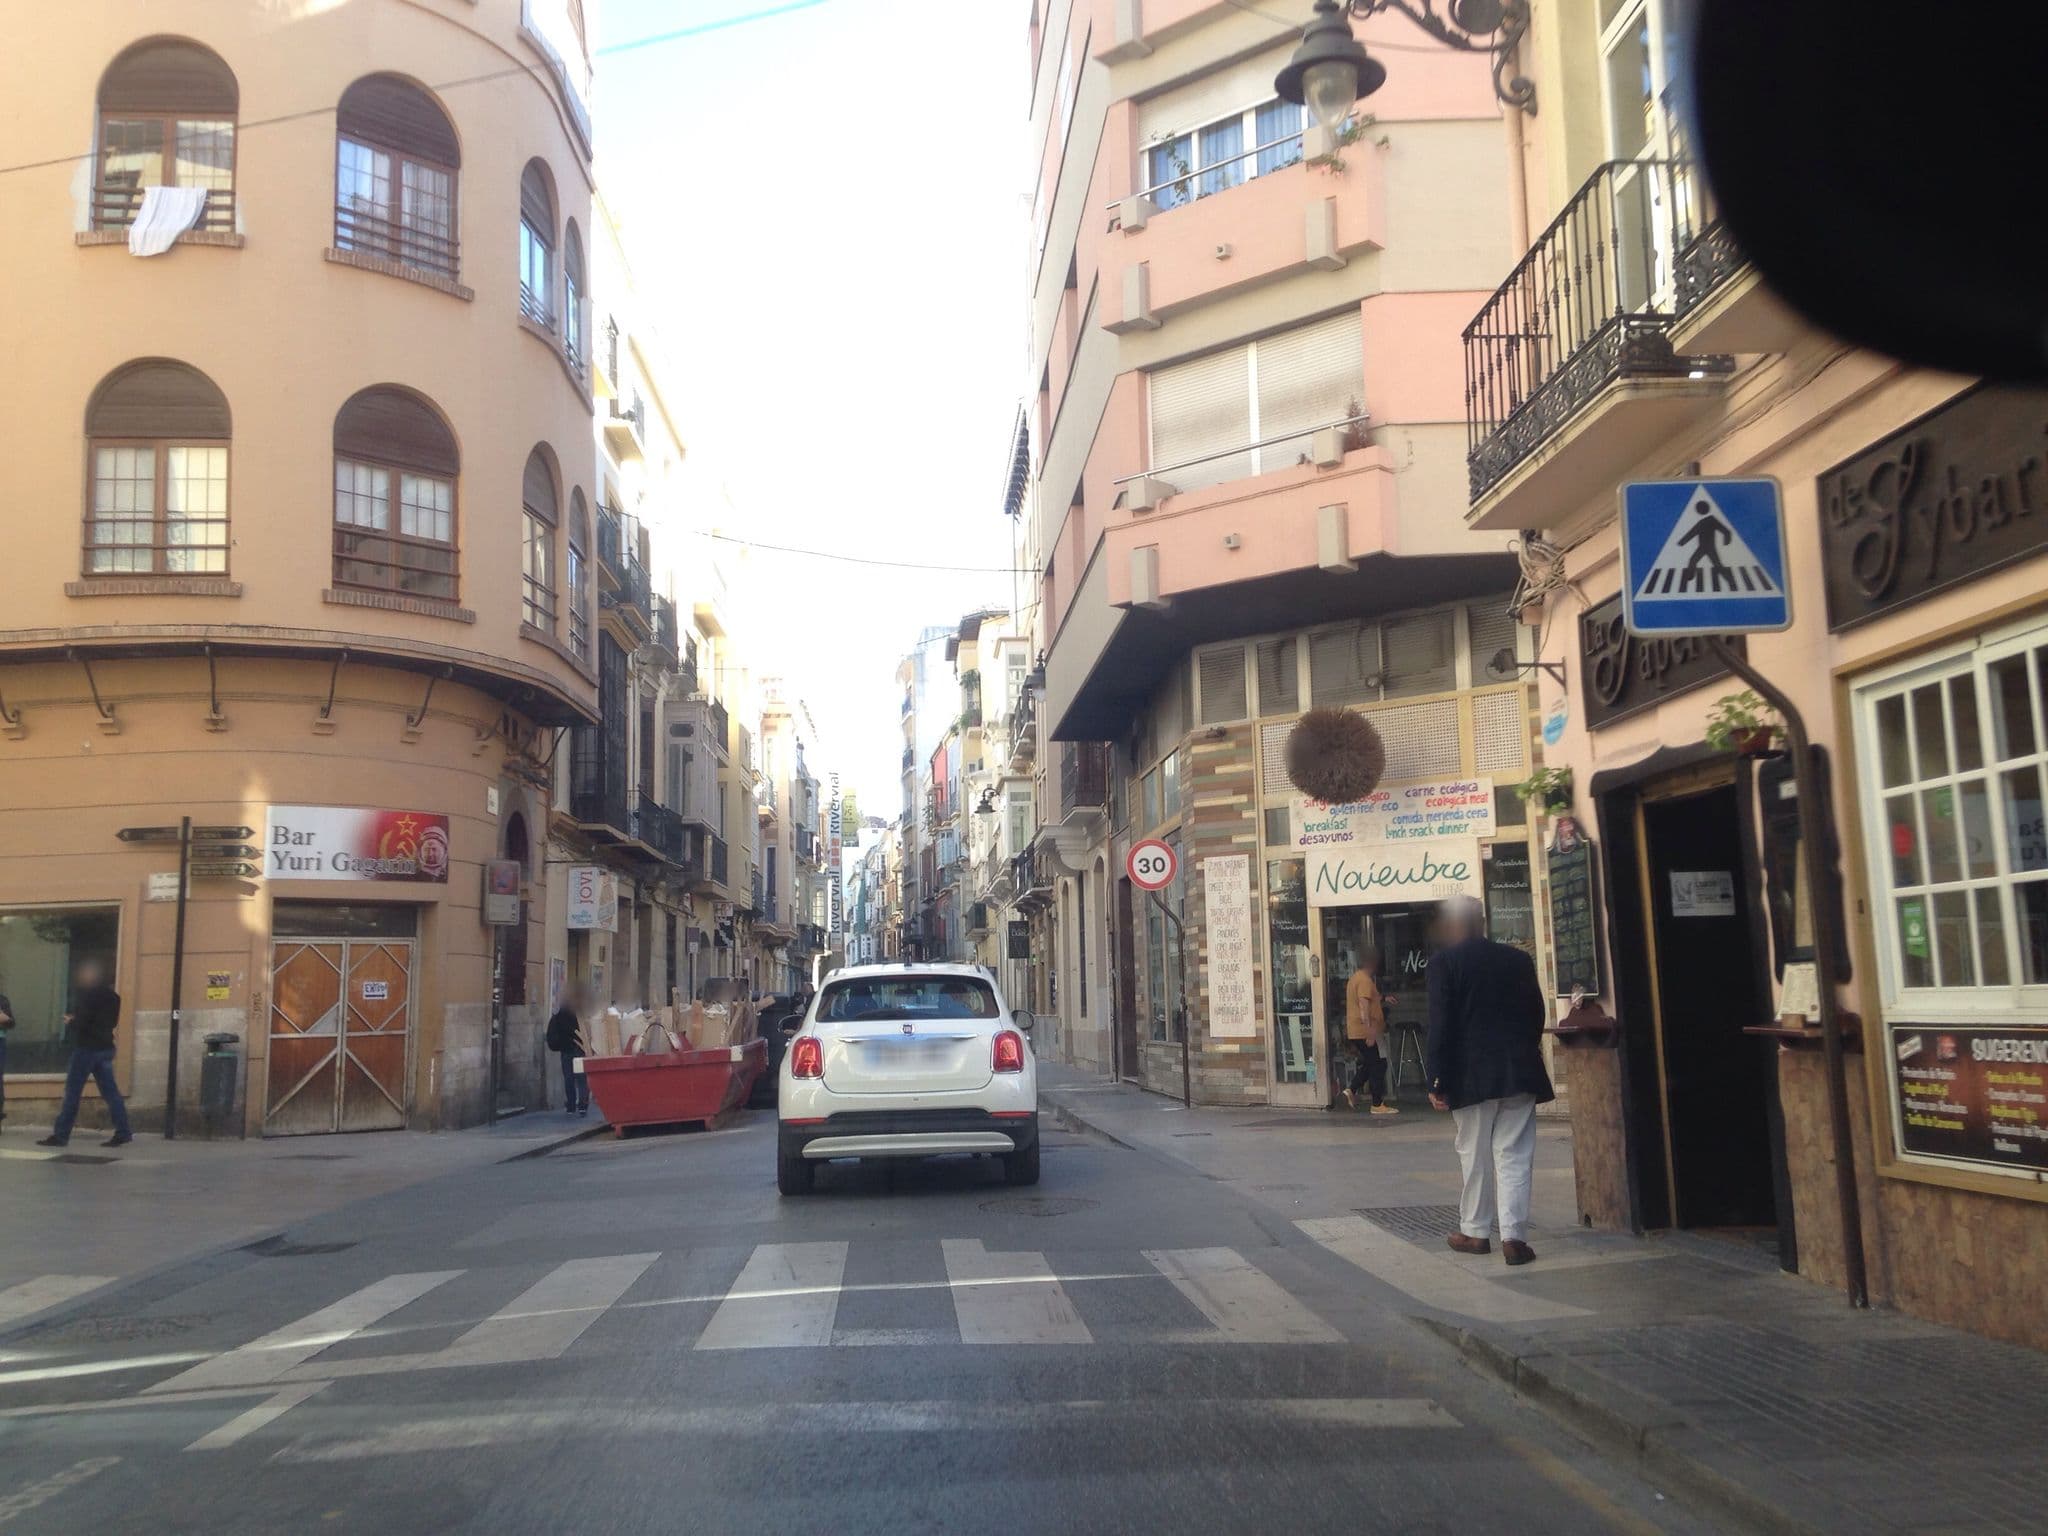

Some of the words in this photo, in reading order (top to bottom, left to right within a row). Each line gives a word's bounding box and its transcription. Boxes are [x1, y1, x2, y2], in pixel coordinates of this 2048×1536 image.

[1405, 786, 1435, 797] carne
[1470, 792, 1488, 803] meat
[829, 772, 841, 834] Rivervial
[1382, 802, 1398, 811] eco
[1304, 816, 1348, 832] breakfast
[1392, 811, 1423, 824] comida
[1427, 809, 1464, 822] merienda
[1466, 808, 1488, 818] cena
[272, 825, 316, 846] Bar
[1299, 832, 1354, 845] desayunos
[1386, 824, 1406, 839] lunch
[1409, 823, 1433, 837] snack
[1437, 822, 1469, 835] dinner
[272, 850, 322, 871] Yuri
[331, 852, 417, 878] Gagarin
[1139, 857, 1165, 873] 30
[580, 871, 593, 904] JOVI
[829, 870, 840, 934] Rivervial
